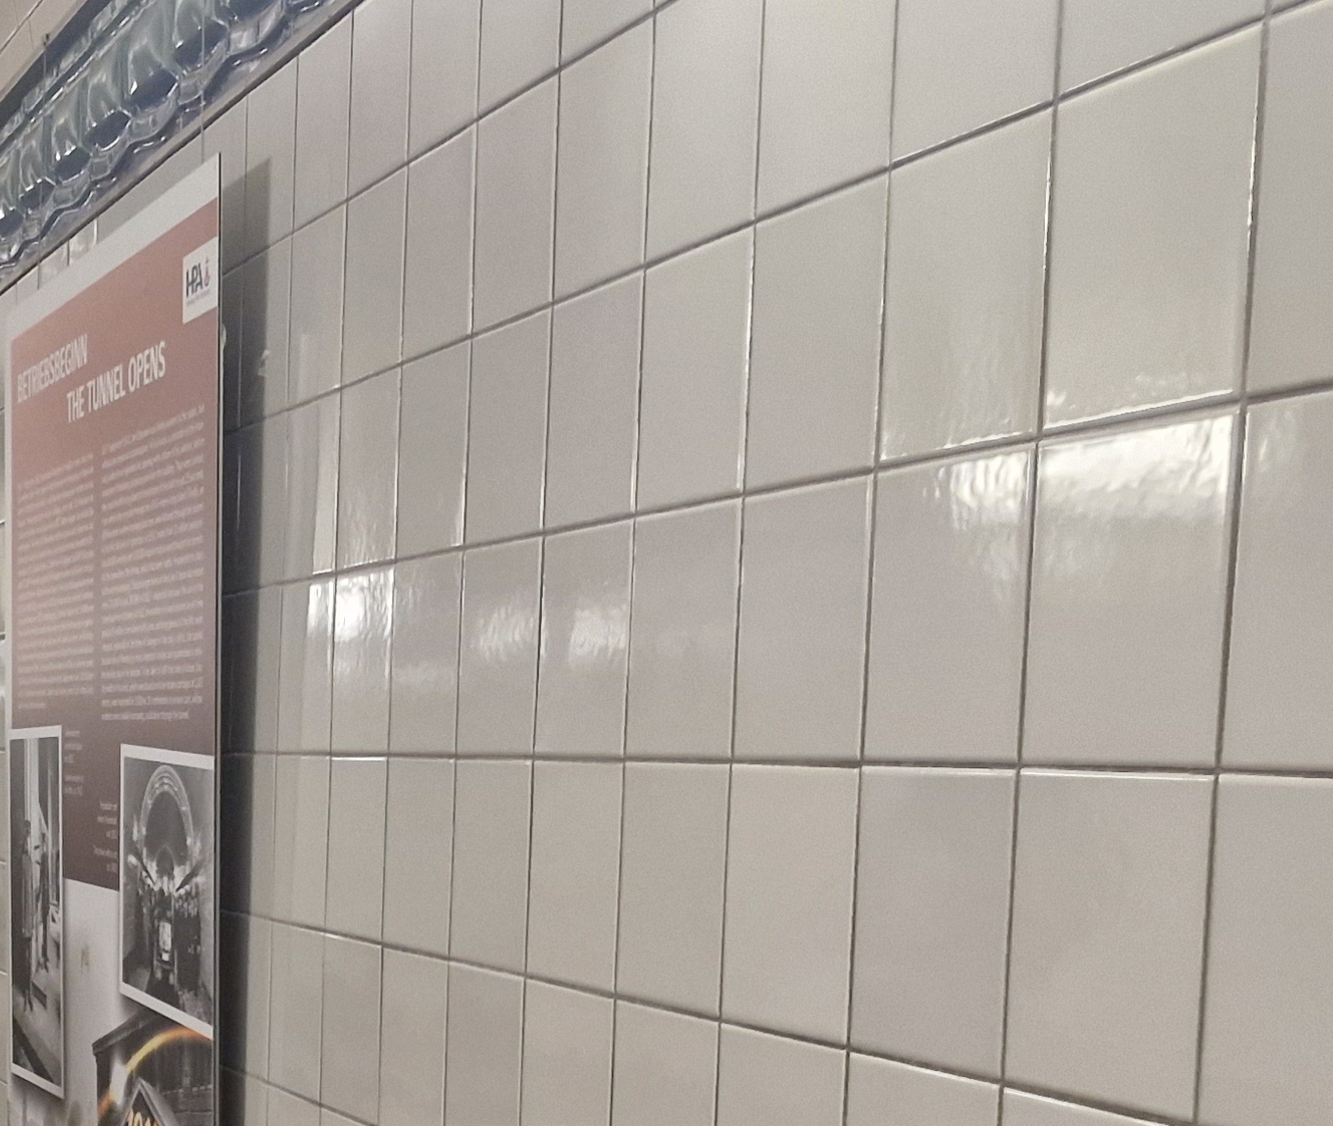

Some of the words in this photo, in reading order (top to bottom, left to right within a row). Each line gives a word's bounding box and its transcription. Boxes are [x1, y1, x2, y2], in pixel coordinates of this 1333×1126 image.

[186, 262, 203, 298] HPA
[16, 333, 89, 404] BETRIEBSBEGINN
[66, 383, 85, 423] THE
[87, 362, 126, 411] TUNNEL
[128, 340, 166, 393] OPENS
